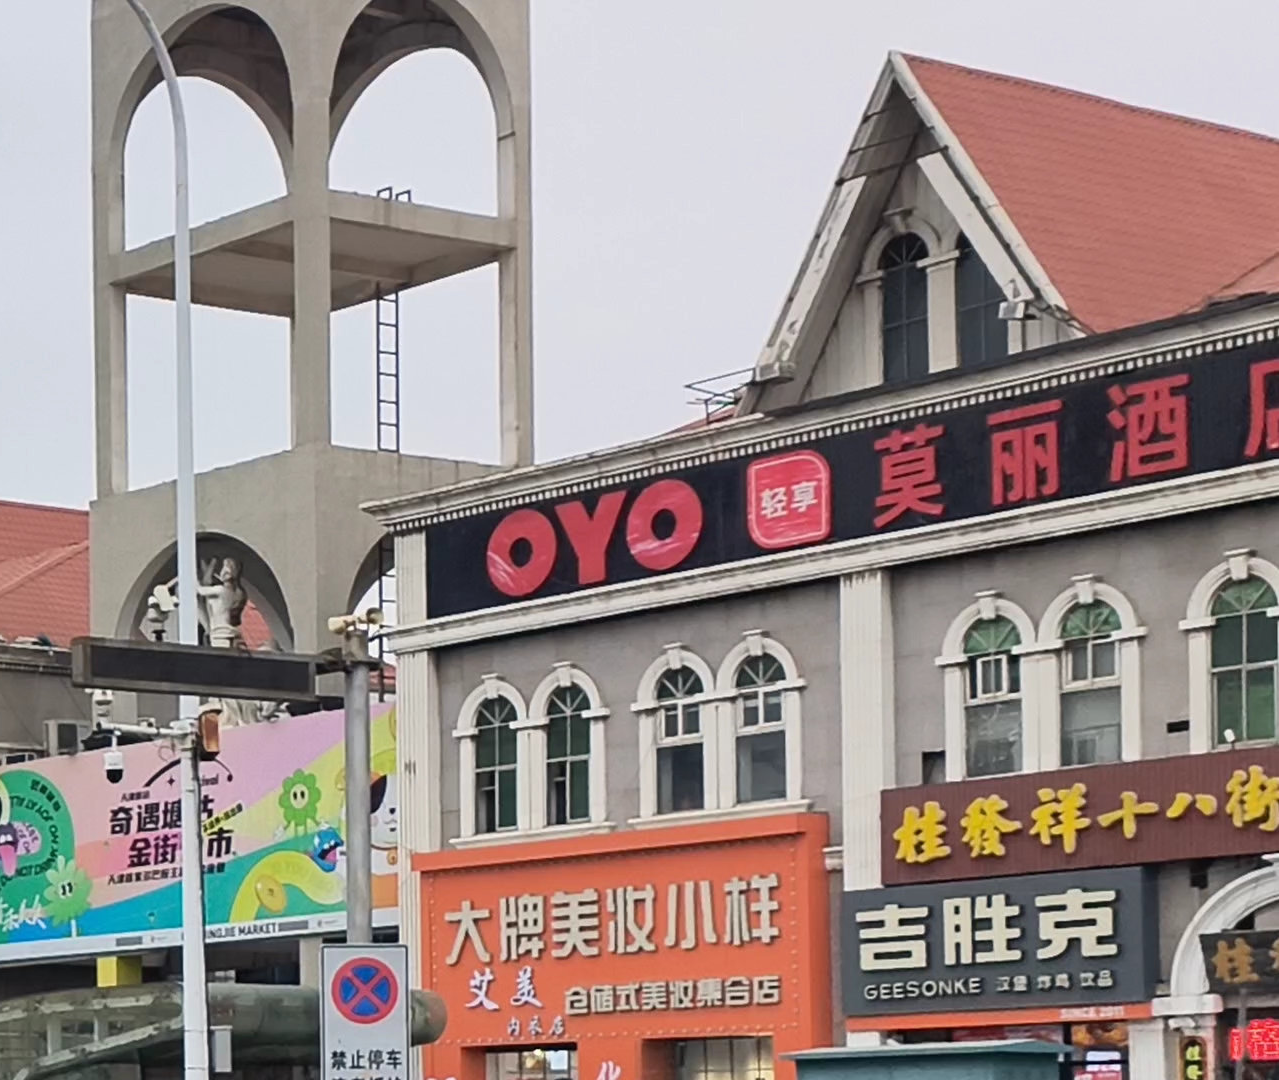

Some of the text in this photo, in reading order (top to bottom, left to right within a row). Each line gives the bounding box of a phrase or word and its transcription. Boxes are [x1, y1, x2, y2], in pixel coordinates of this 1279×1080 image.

[760, 480, 819, 519] 轻享
[486, 478, 703, 597] OYO
[128, 827, 234, 868] 金街市
[444, 872, 780, 966] 大牌美妆小样
[855, 889, 1118, 971] 吉胜克
[465, 966, 542, 1011] 艾美
[565, 976, 780, 1016] 仓储式美妆集合店
[864, 977, 983, 1000] GEESONKE
[1080, 970, 1113, 987] 饮品
[331, 1048, 403, 1070] 禁止停车
